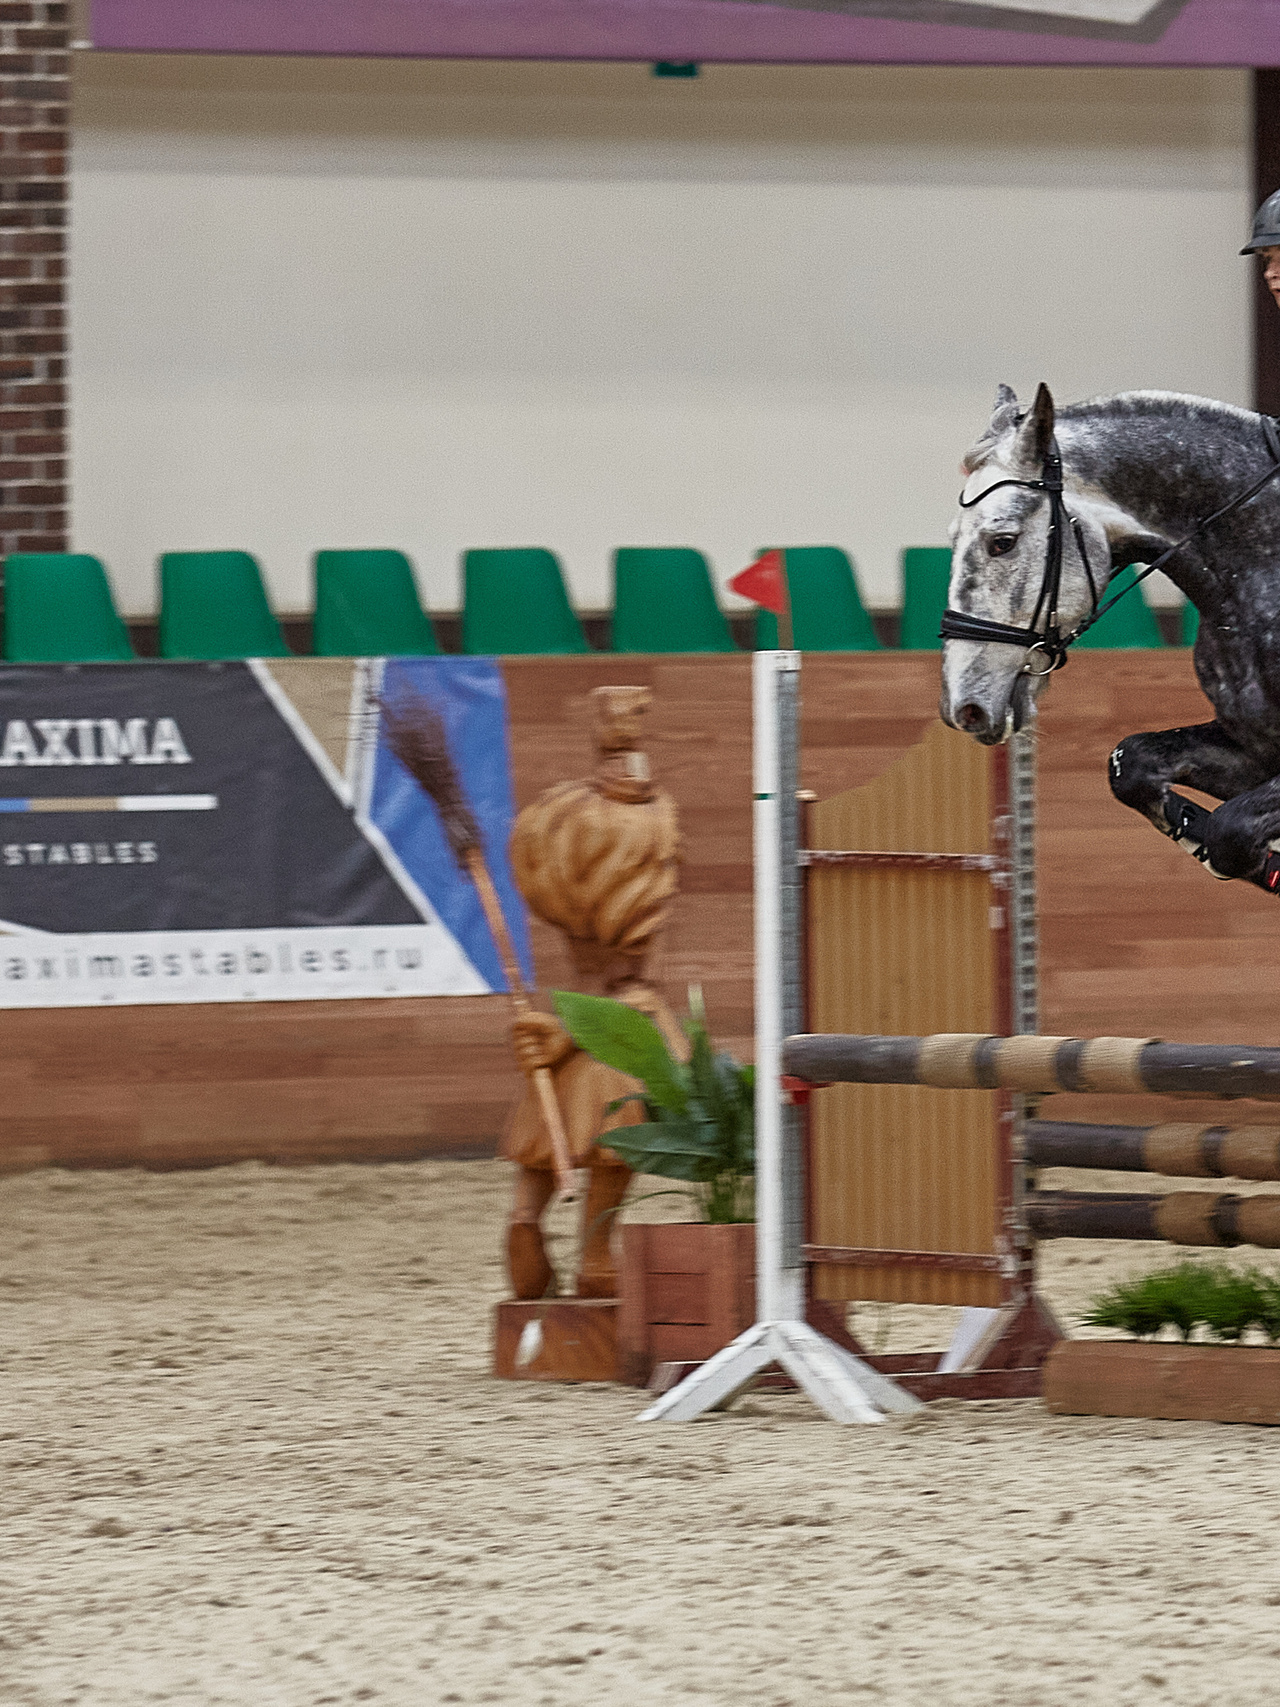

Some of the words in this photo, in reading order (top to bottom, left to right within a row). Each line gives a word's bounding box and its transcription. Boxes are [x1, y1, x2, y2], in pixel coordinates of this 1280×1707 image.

[0, 718, 193, 766] AXIMA
[2, 841, 159, 867] STABLES
[3, 944, 424, 981] aximastables.ru
